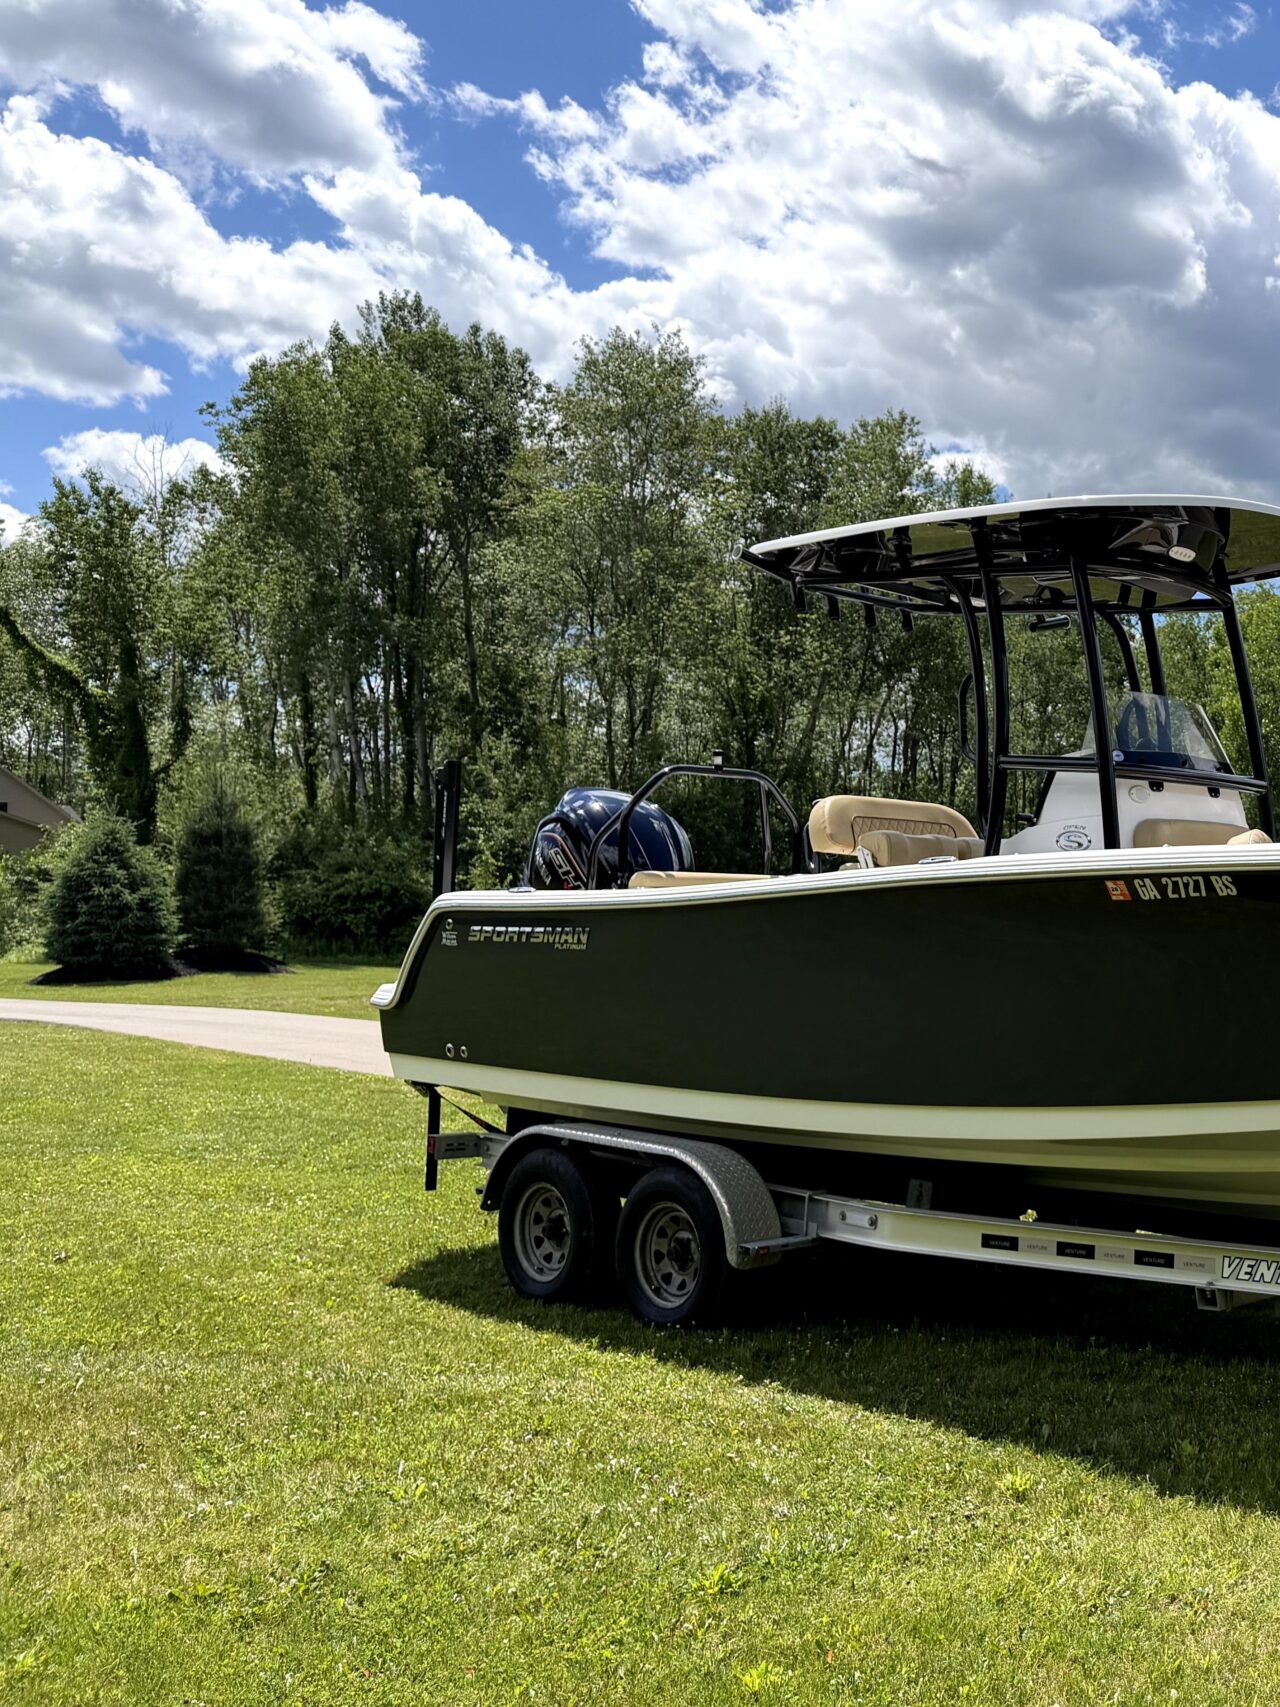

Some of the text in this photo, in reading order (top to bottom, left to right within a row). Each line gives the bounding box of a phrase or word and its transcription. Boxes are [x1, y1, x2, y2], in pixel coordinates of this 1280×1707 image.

[1134, 875, 1238, 900] GA 2727 BS
[468, 926, 590, 944] SPORTSMAN
